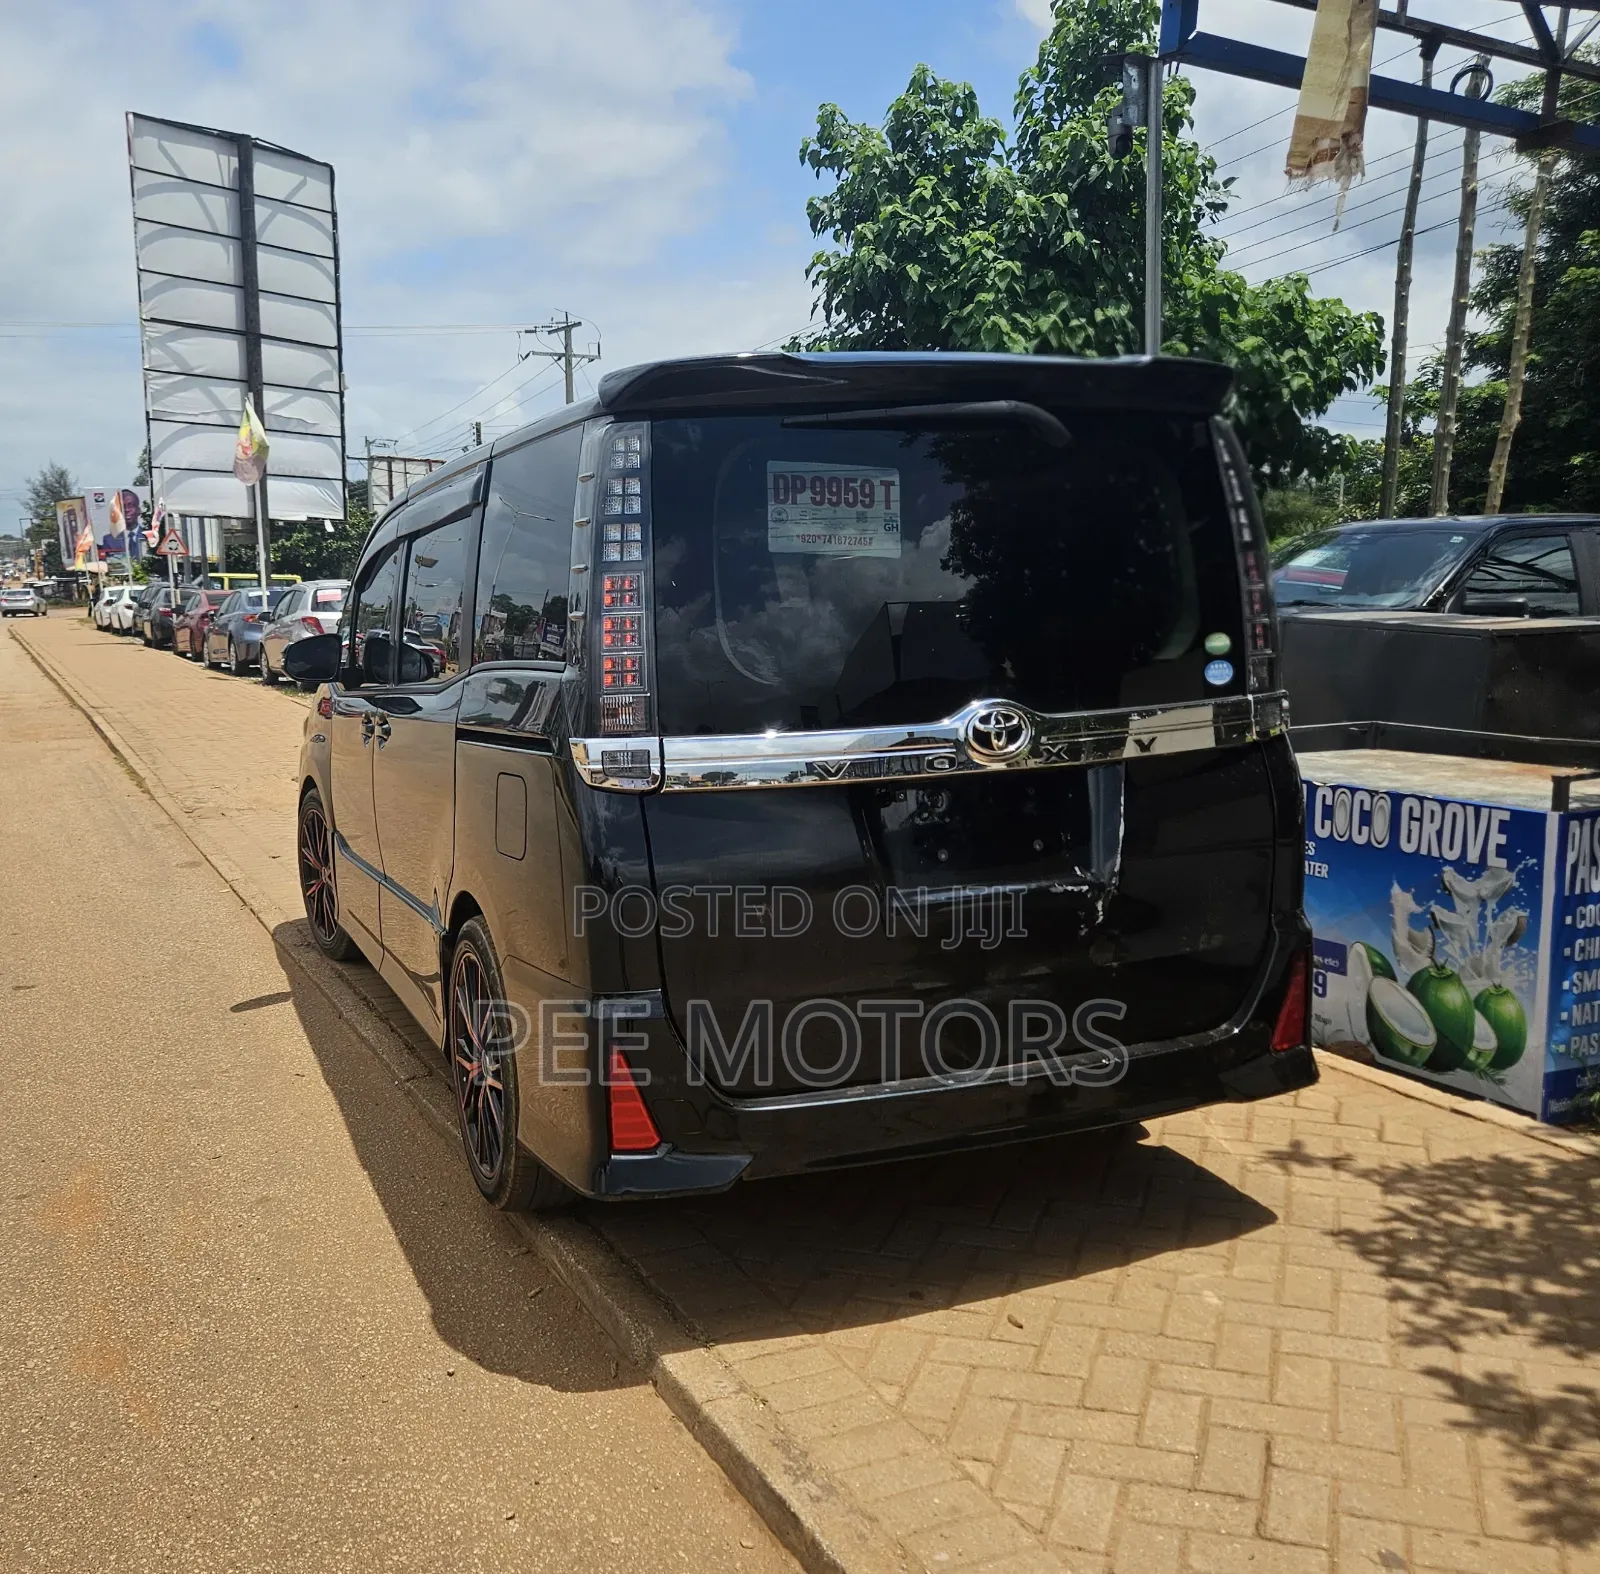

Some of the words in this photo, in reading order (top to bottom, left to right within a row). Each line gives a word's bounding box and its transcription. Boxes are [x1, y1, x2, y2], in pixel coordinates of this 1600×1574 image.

[773, 473, 806, 505] DP
[809, 475, 875, 509] 9959
[880, 480, 895, 510] T
[883, 523, 899, 532] GH
[1314, 786, 1392, 848] COCO
[1400, 797, 1510, 869] GROVE
[1572, 969, 1600, 995] SM
[1570, 1033, 1600, 1059] PAS
